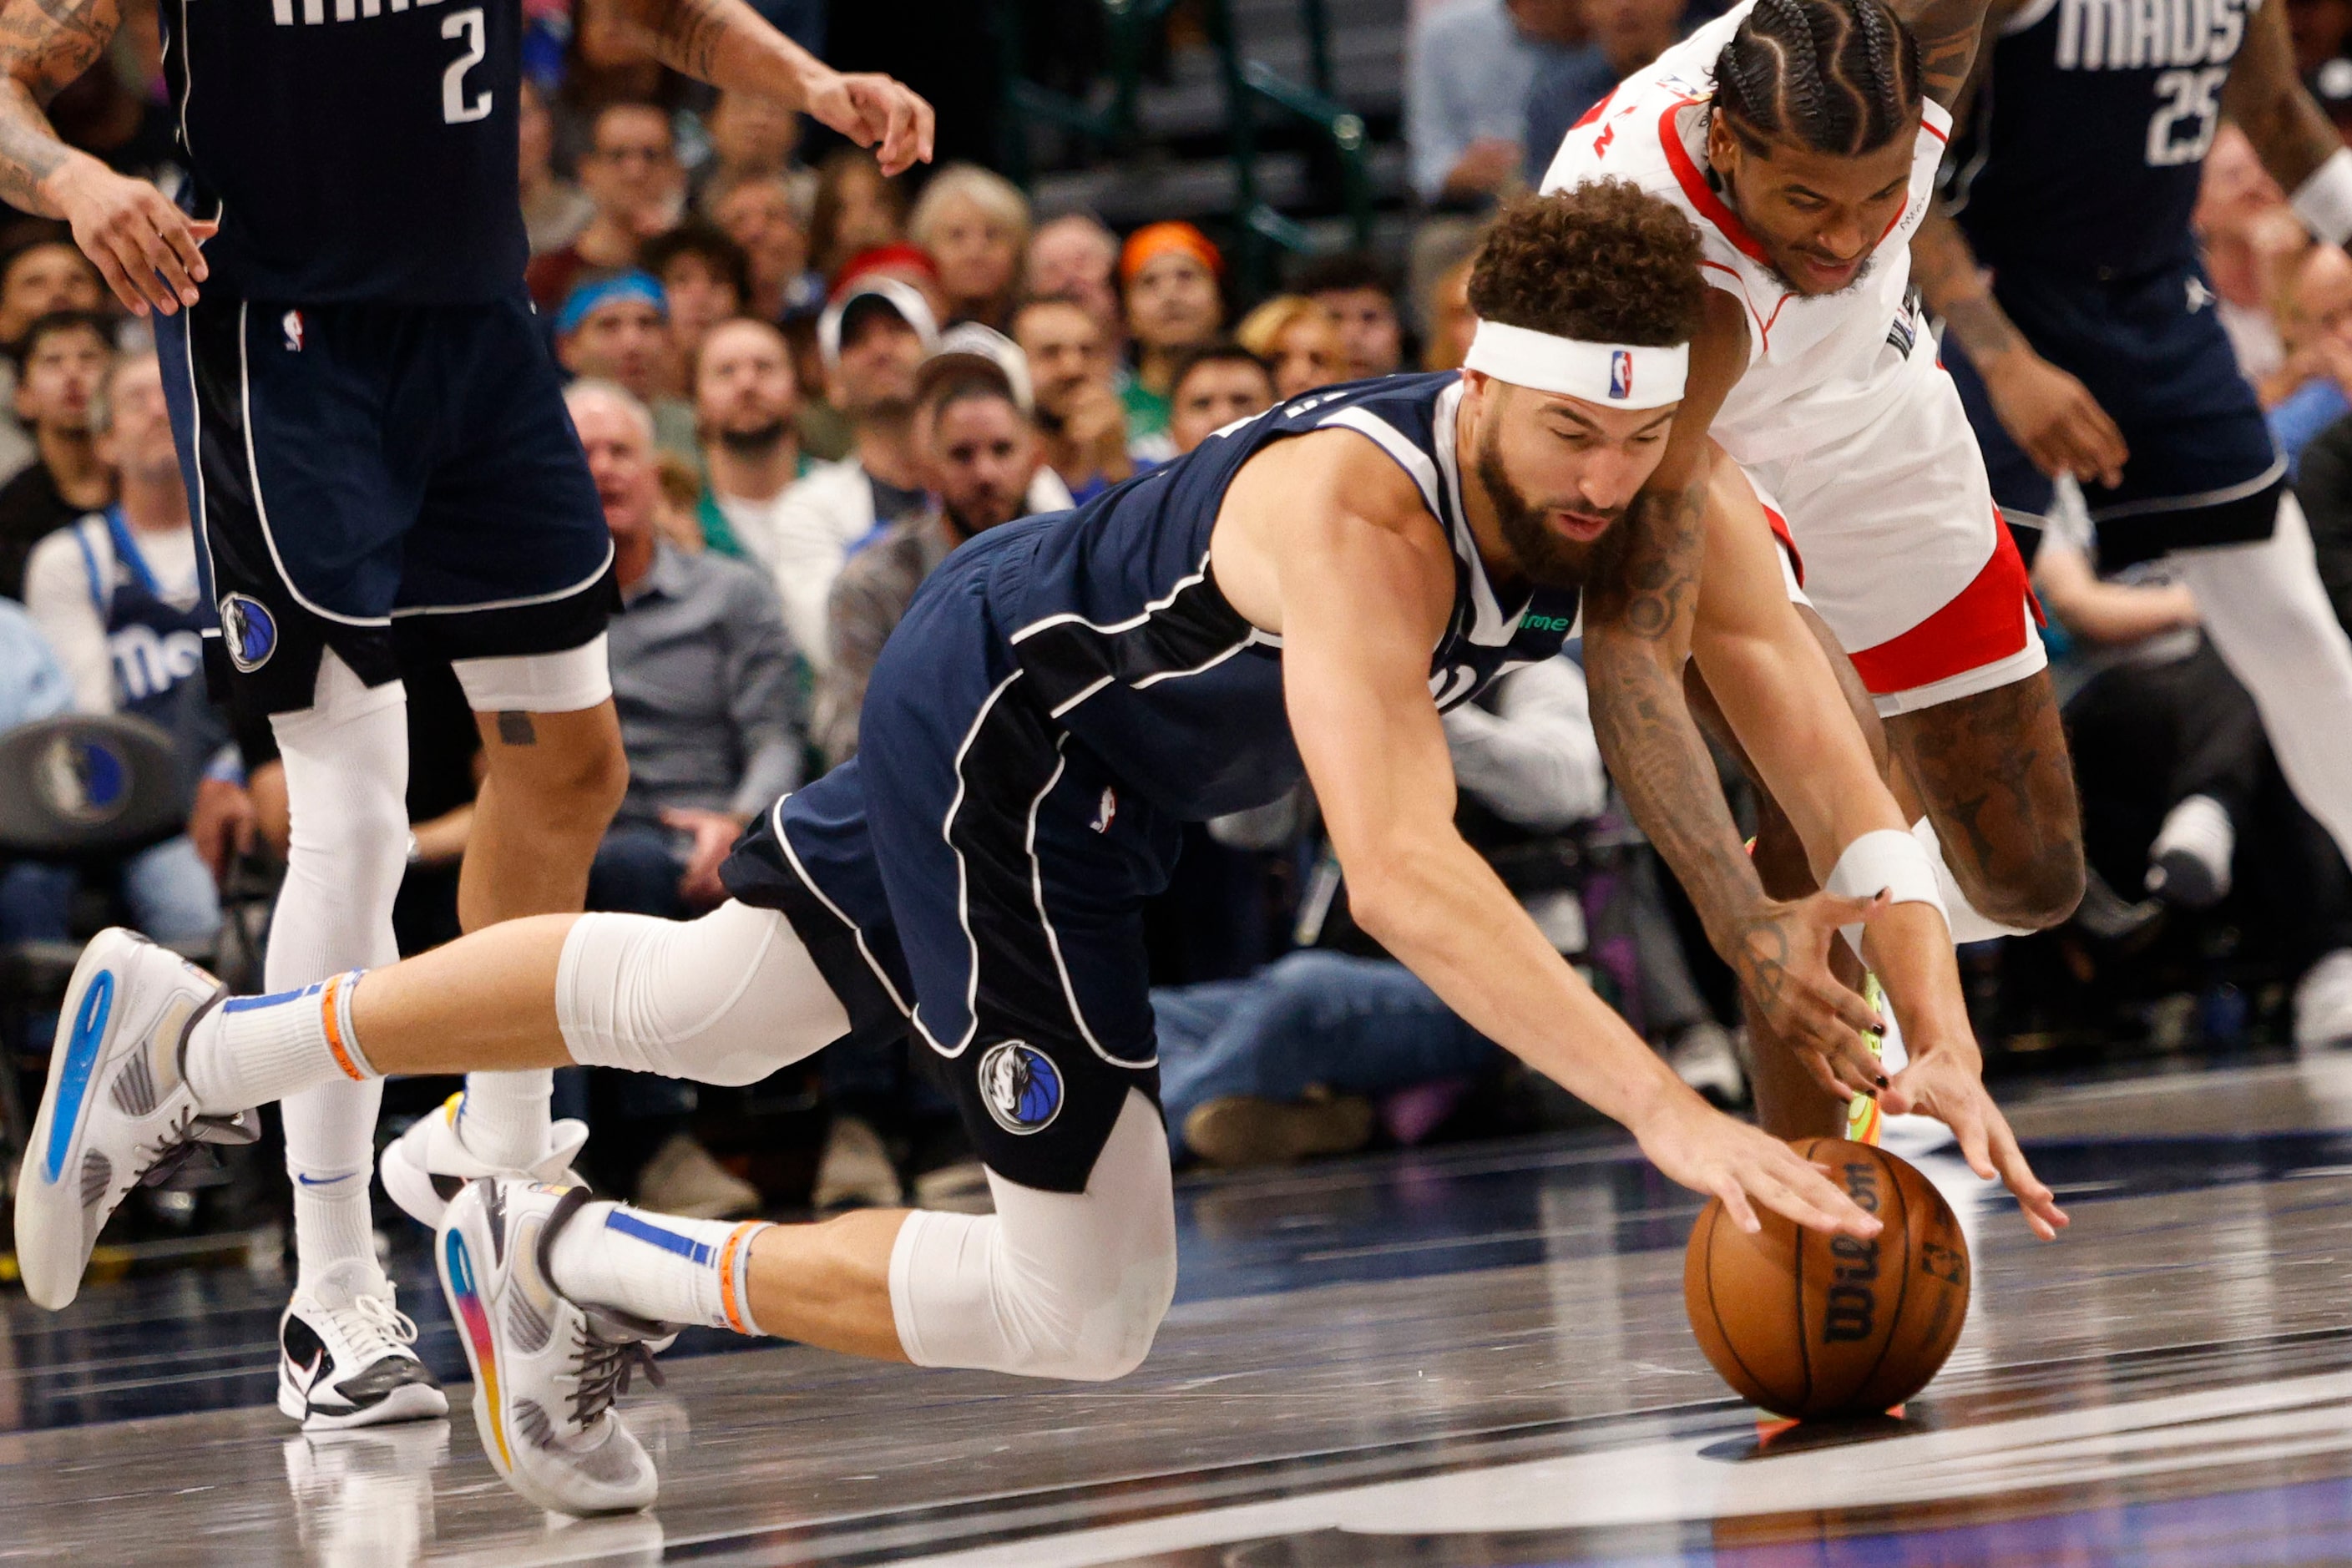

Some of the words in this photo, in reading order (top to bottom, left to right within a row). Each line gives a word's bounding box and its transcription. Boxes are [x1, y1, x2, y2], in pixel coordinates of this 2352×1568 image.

[442, 7, 493, 124] 2
[2144, 66, 2231, 166] 25
[1823, 1162, 1880, 1344] Wilon
